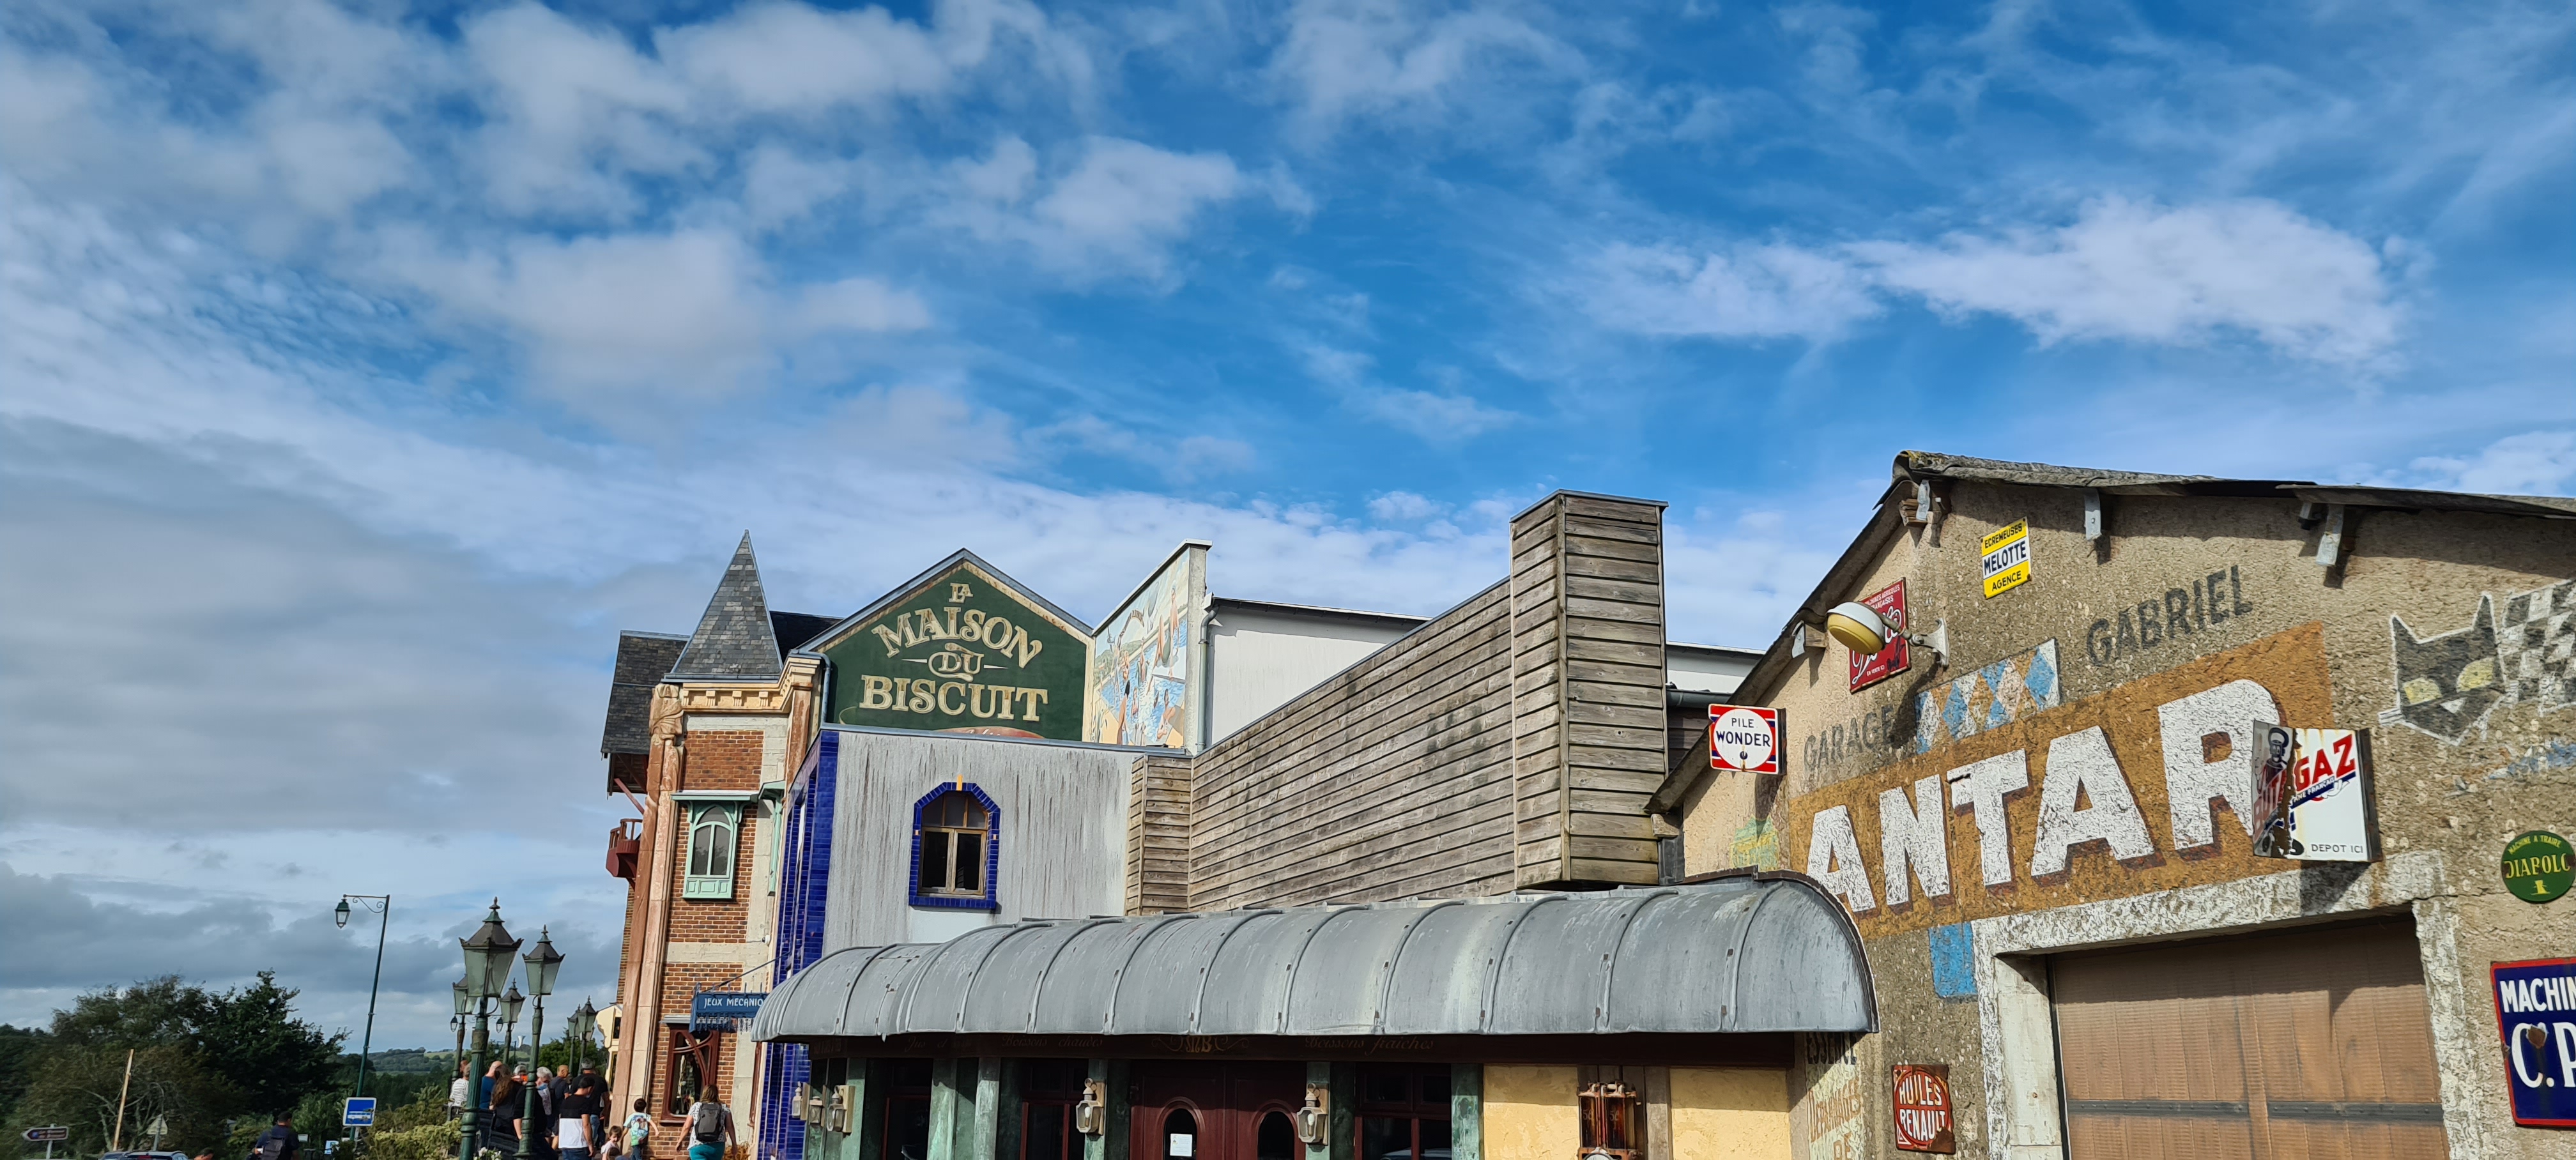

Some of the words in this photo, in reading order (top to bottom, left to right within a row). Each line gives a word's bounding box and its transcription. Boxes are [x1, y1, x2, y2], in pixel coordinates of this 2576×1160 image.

[1984, 523, 2023, 549] ECREMEUSES
[1984, 540, 2027, 576] MELOTTE
[949, 583, 973, 603] LA
[1992, 570, 2022, 591] AGENCE
[2087, 565, 2253, 666] GABRIEL
[871, 607, 1043, 668] MAISON
[928, 642, 984, 682] DU
[859, 674, 1049, 722] BISCUIT
[1716, 731, 1770, 747] WONDER
[1731, 718, 1754, 728] PILE
[1804, 704, 1896, 770] GARAGE
[1807, 680, 2281, 912] ANTAR
[2311, 844, 2347, 853] DEPOT
[2350, 844, 2363, 853] ICI
[2508, 836, 2531, 855] MACHINE
[2540, 835, 2561, 848] TRAIRE
[704, 998, 723, 1009] JEUX
[1899, 1074, 1942, 1106] HUILES
[1900, 1109, 1945, 1141] RENAULT
